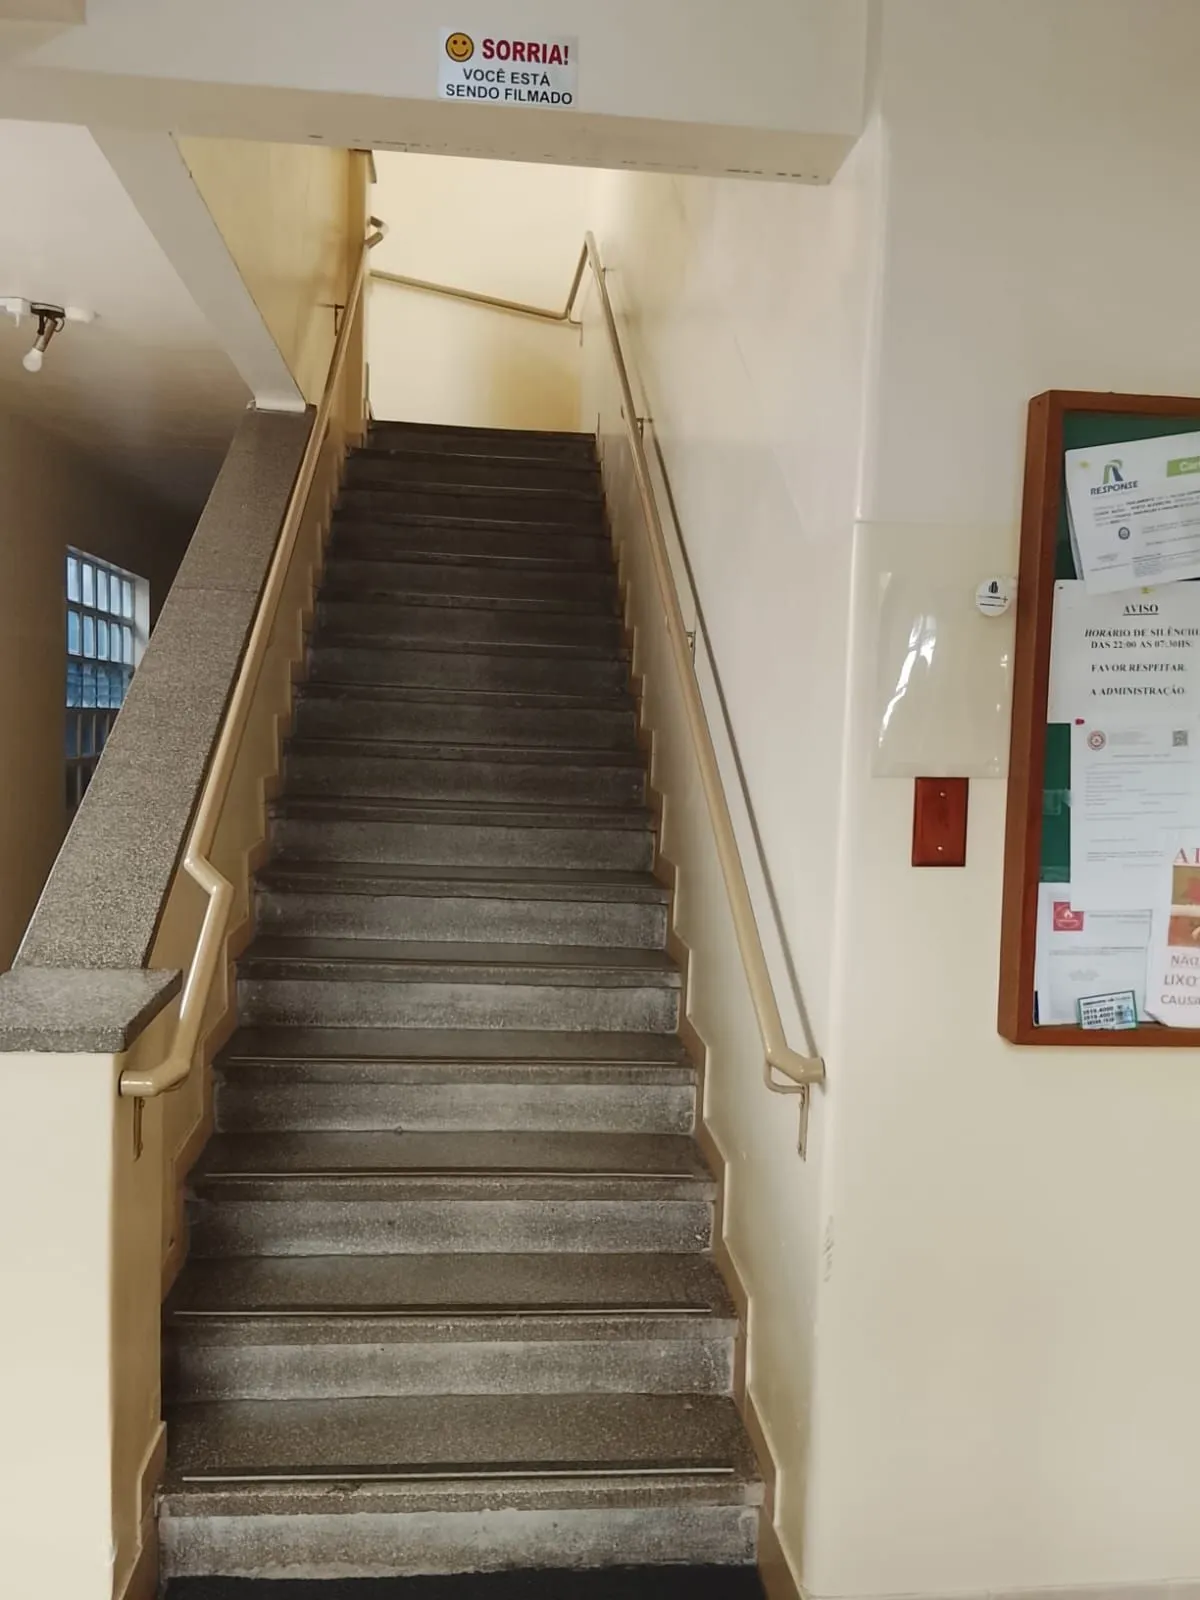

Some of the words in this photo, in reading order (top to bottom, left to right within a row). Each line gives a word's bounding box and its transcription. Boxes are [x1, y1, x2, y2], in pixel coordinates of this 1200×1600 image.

[482, 39, 569, 65] SORRIA!
[463, 68, 505, 83] VOCÊ
[511, 71, 551, 86] ESTÁ
[446, 84, 499, 100] SENDO
[505, 88, 573, 104] FILMADO
[1090, 480, 1139, 495] RESPONSE
[1123, 604, 1159, 614] AVISO
[1084, 627, 1131, 637] HORÁRIO
[1134, 628, 1147, 637] DE
[1091, 640, 1111, 649] DAS
[1091, 663, 1127, 672] FAVOR
[1090, 688, 1097, 696] A
[1164, 974, 1197, 987] LIXO
